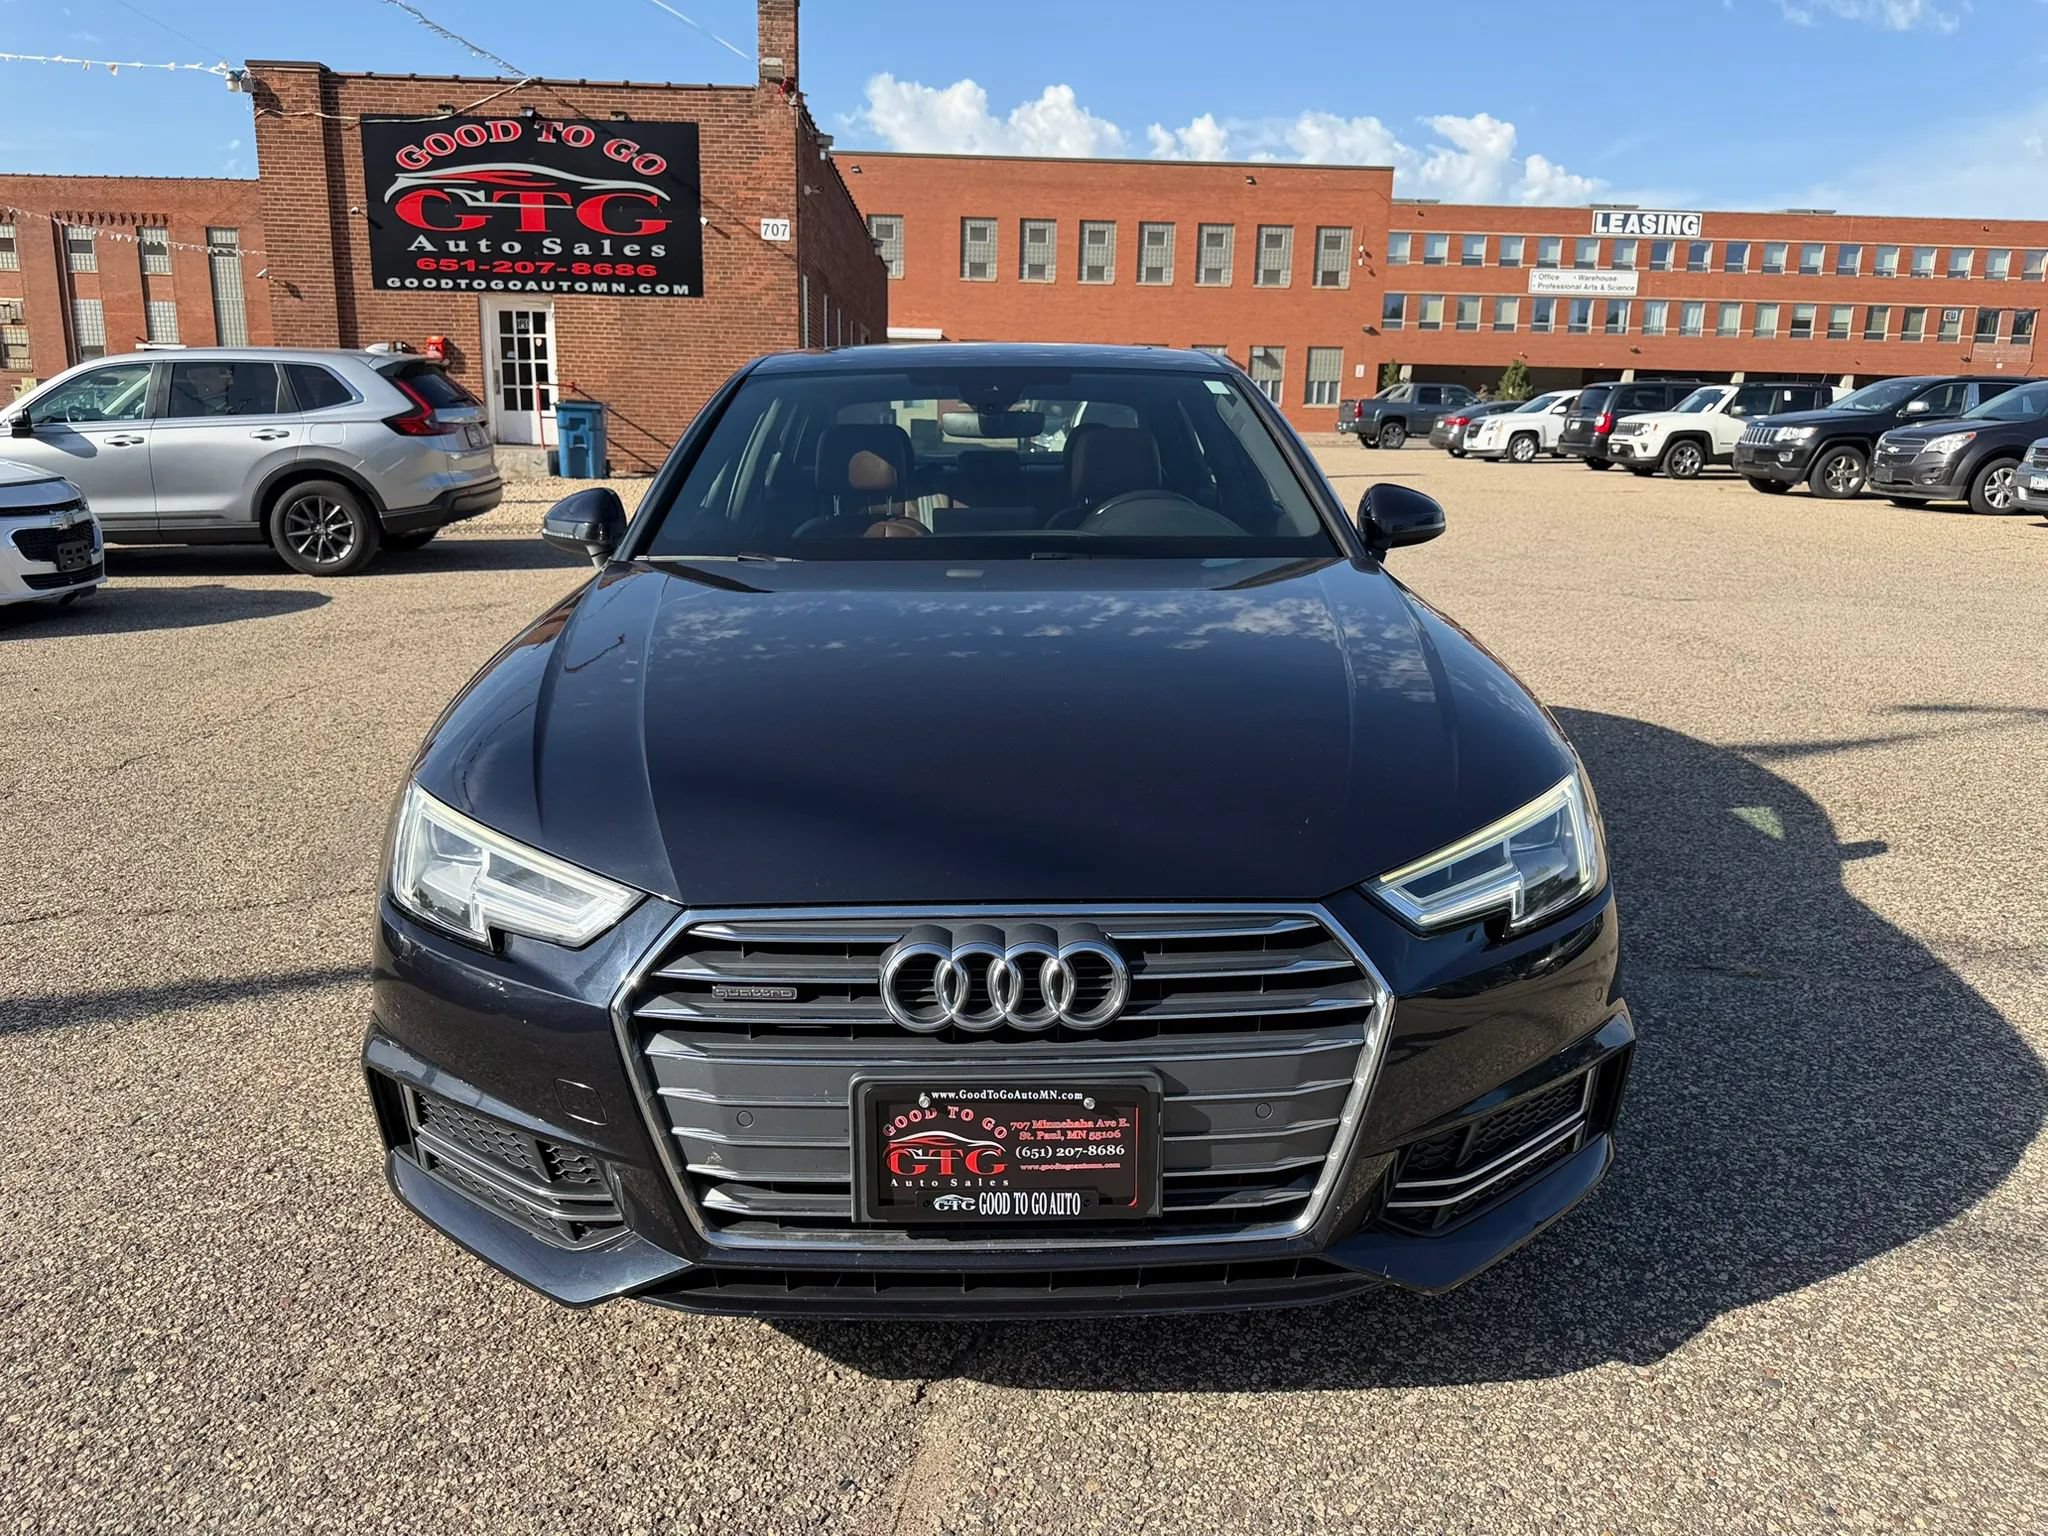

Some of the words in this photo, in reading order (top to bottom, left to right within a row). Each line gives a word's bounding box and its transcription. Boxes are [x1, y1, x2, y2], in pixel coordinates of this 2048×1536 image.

[396, 120, 522, 170] GOOD
[534, 121, 595, 147] TO
[603, 138, 667, 175] GO
[395, 189, 672, 236] GTG
[763, 223, 788, 237] 707
[1595, 213, 1699, 235] LEASING
[407, 235, 522, 255] Auto
[542, 238, 666, 257] Sales
[416, 258, 657, 277] 651-207-8686
[1538, 273, 1560, 281] Office
[1578, 274, 1617, 282] Warehouse
[386, 277, 689, 295] GOODTOGOAUTOMN.COM
[1537, 282, 1581, 290] Professional
[715, 987, 793, 998] quattro
[931, 1089, 1083, 1100] www.GoodToGoAutoMN.com
[882, 1107, 938, 1137] GOOD
[947, 1105, 975, 1122] TO
[981, 1117, 1008, 1139] GO
[1009, 1121, 1030, 1131] 707
[1095, 1119, 1116, 1128] Ave
[1118, 1118, 1130, 1127] E.
[1019, 1131, 1034, 1140] St.
[1036, 1130, 1064, 1141] Paul,
[1066, 1130, 1088, 1140] MN
[1015, 1145, 1053, 1159] (651)
[1056, 1144, 1125, 1158] 207-8686
[887, 1148, 1008, 1176] GTG
[890, 1178, 939, 1187] Auto
[950, 1178, 1009, 1187] Sales
[934, 1200, 976, 1211] GTG
[979, 1192, 1011, 1215] GOOD
[1013, 1192, 1029, 1215] TO
[1031, 1192, 1048, 1215] GO
[1049, 1192, 1081, 1215] AUTO
